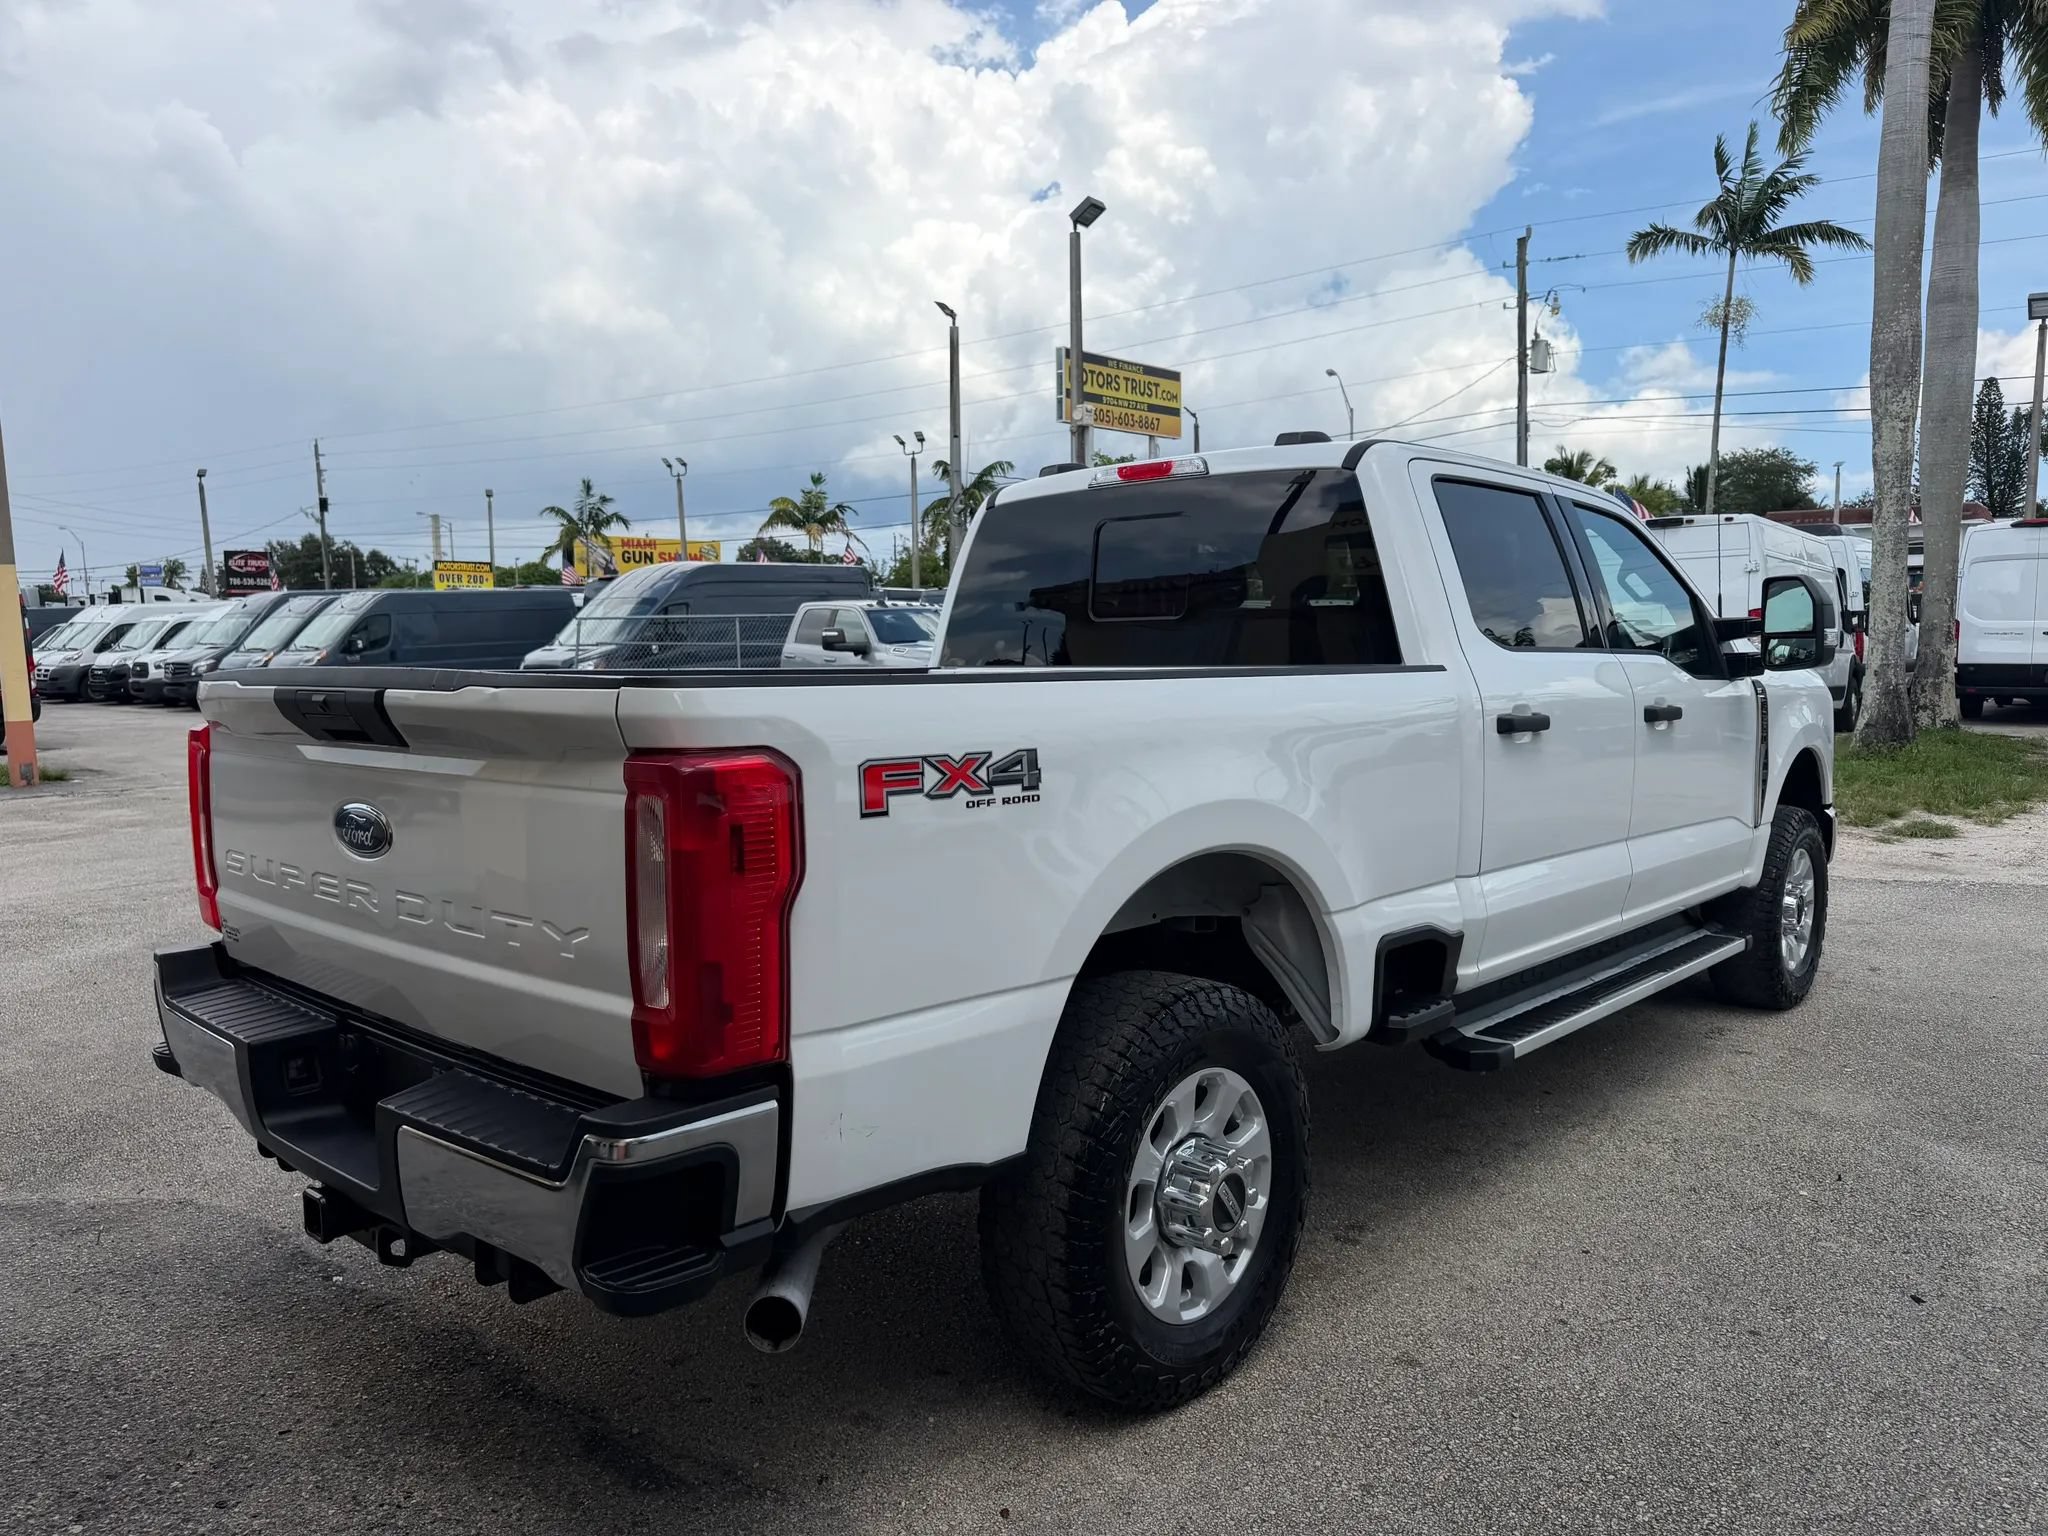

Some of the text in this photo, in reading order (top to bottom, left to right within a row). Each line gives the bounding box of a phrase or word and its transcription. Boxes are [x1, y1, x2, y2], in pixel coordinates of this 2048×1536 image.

[1107, 360, 1144, 375] WE FINANCE
[1069, 366, 1120, 392] OTORS
[1137, 403, 1148, 411] AVE
[1093, 407, 1161, 431] 305)-603-8867
[621, 539, 657, 550] MIAMI
[621, 551, 654, 564] GUN
[438, 573, 463, 583] OVER
[858, 748, 1041, 820] FX4
[966, 794, 1041, 809] OFF ROAD
[342, 813, 375, 847] Ford
[225, 848, 589, 958] SUPER DUTY
